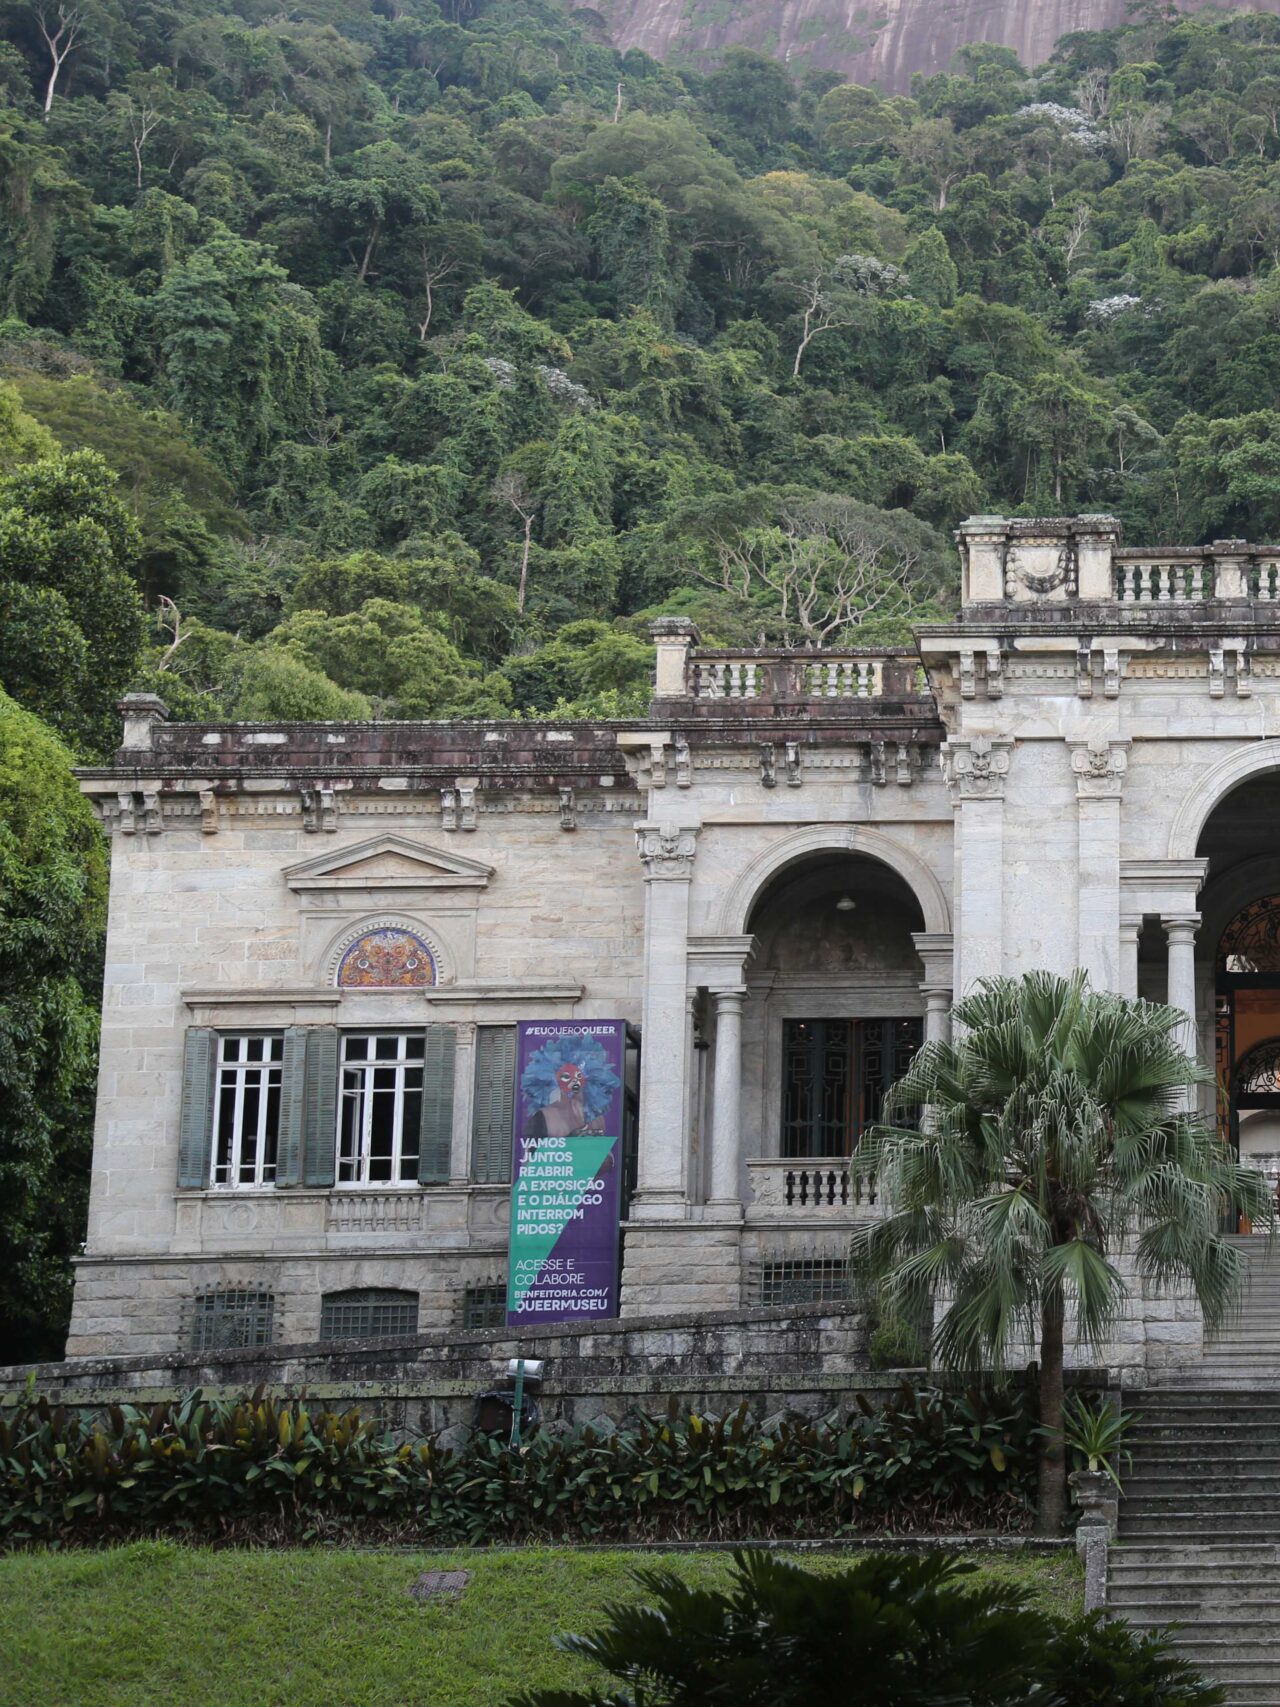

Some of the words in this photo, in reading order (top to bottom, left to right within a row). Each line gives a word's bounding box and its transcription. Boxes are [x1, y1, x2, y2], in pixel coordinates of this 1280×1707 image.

[525, 1026, 615, 1035] #EUQUEROQUEER
[520, 1137, 566, 1148] VAMOS
[519, 1151, 573, 1163] JUNTOS
[519, 1166, 573, 1177] REABRIR
[518, 1181, 528, 1191] A
[531, 1177, 605, 1194] EXPOSIÇÃO
[518, 1195, 526, 1205] E
[529, 1194, 540, 1205] O
[543, 1191, 603, 1205] DIÁLOGO
[517, 1209, 584, 1220] INTERROM
[517, 1223, 563, 1235] PIDOS?
[515, 1259, 563, 1271] ACESSE
[567, 1259, 575, 1270] E
[514, 1273, 585, 1286] COLABORE
[514, 1288, 608, 1298] BENFEITORIA.COM/
[515, 1299, 607, 1313] QUEERMUSEU
